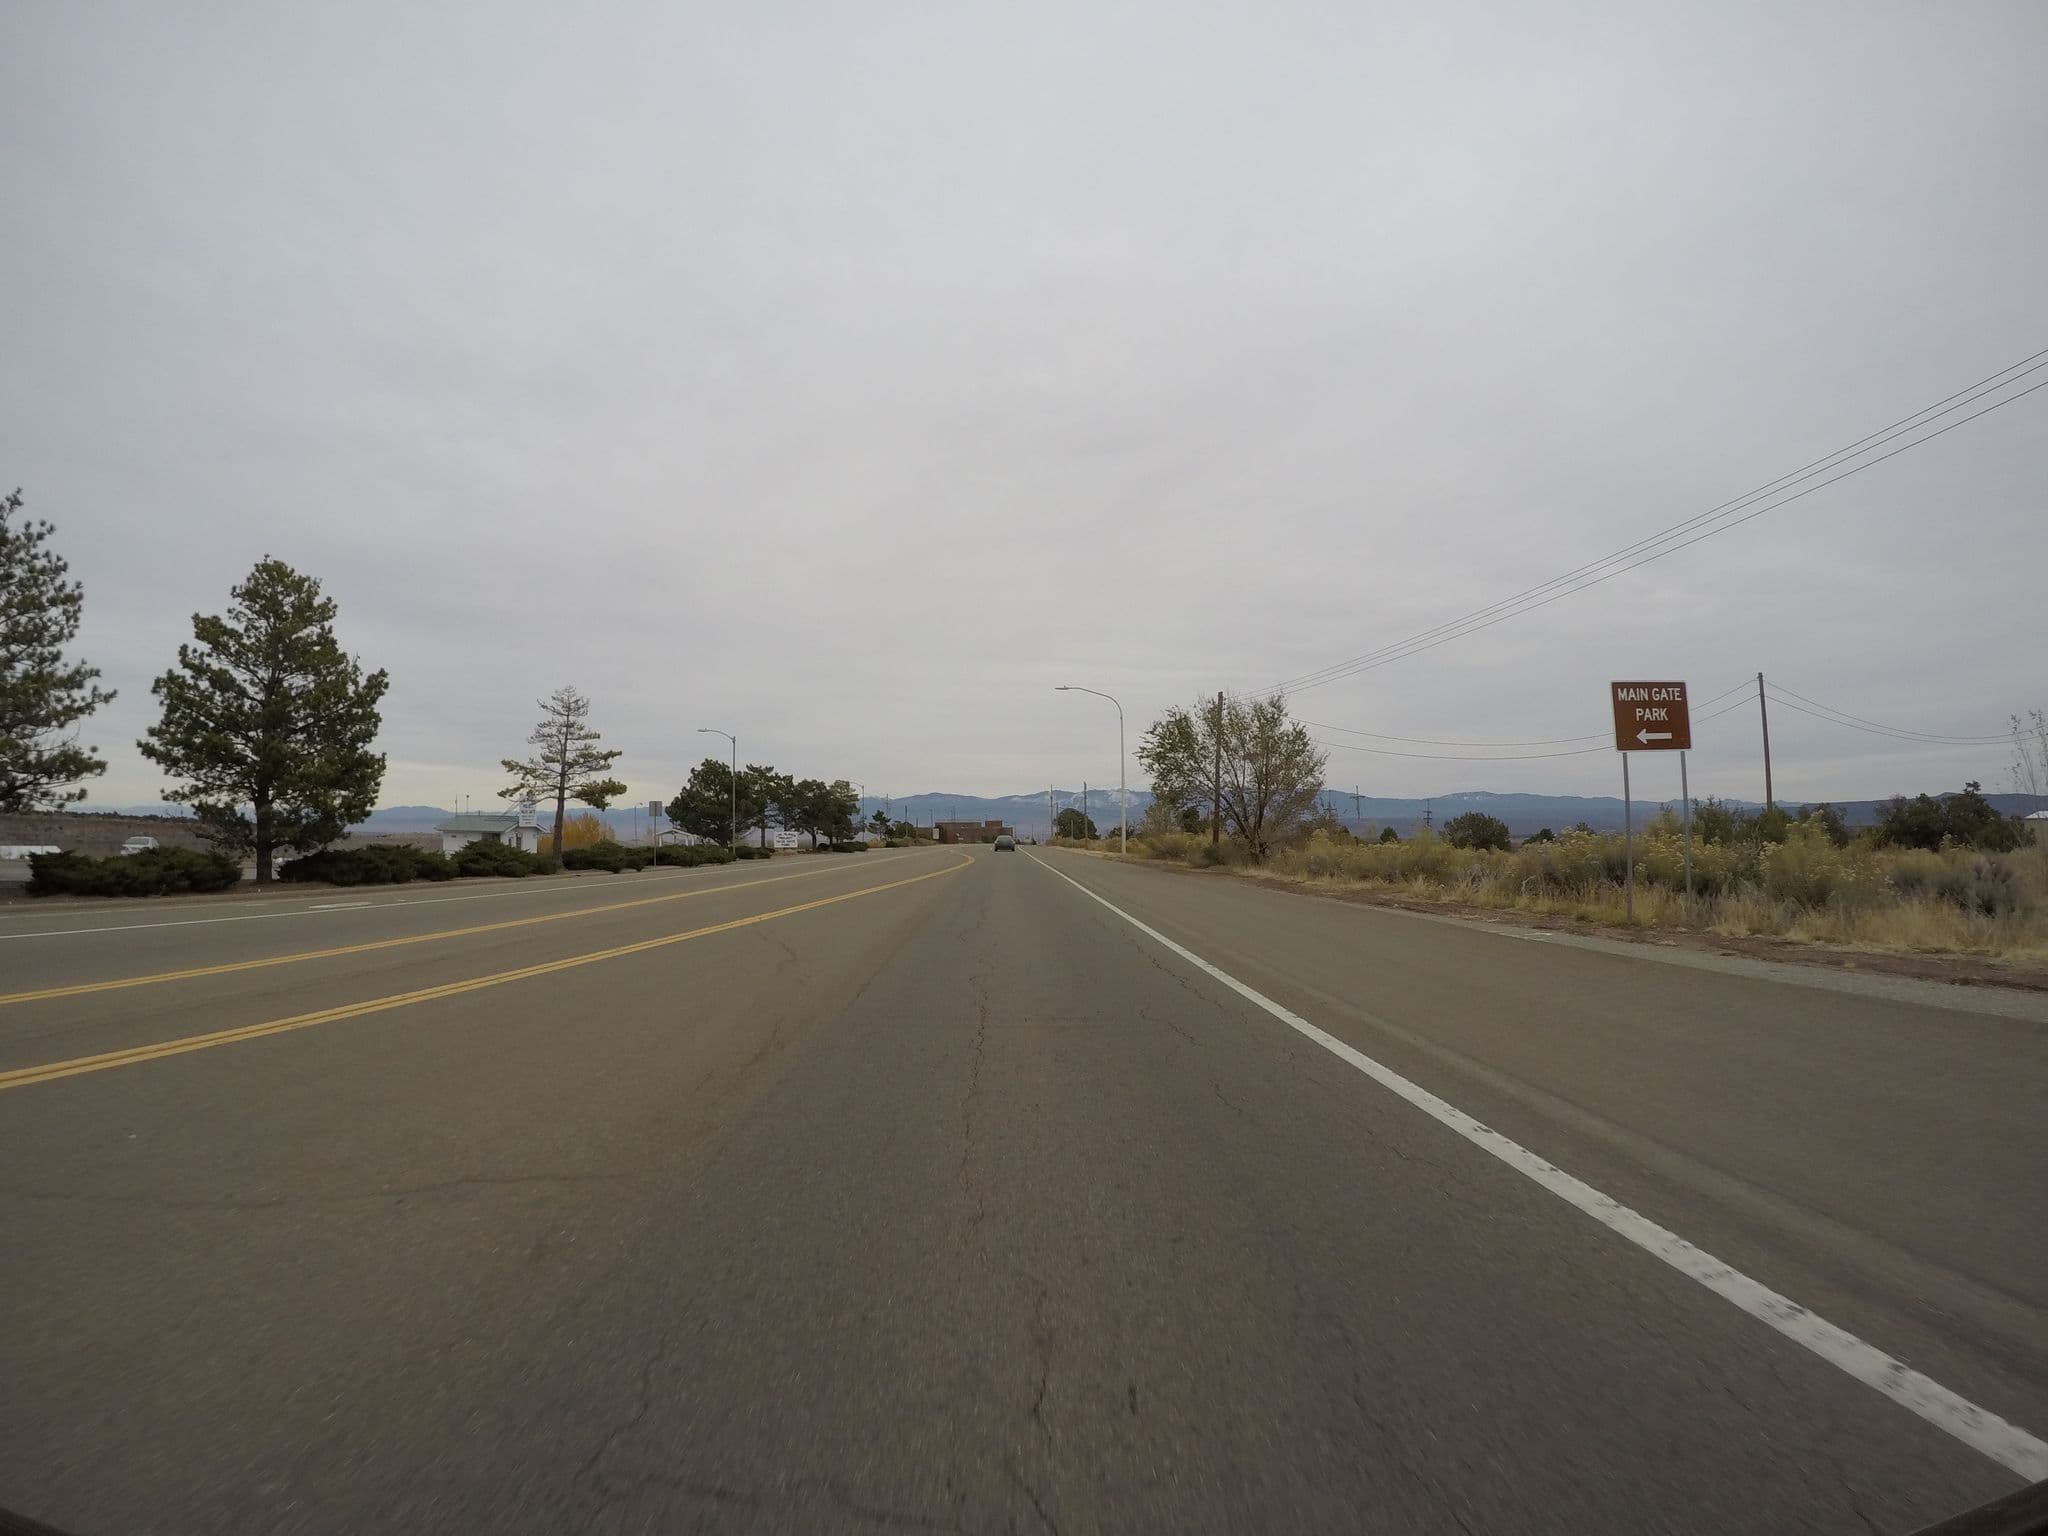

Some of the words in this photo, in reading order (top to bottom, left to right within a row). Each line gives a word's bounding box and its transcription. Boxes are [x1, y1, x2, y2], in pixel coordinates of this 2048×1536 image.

[1617, 687, 1649, 701] MAIN
[1651, 687, 1682, 701] GATE
[1635, 708, 1668, 721] PARK
